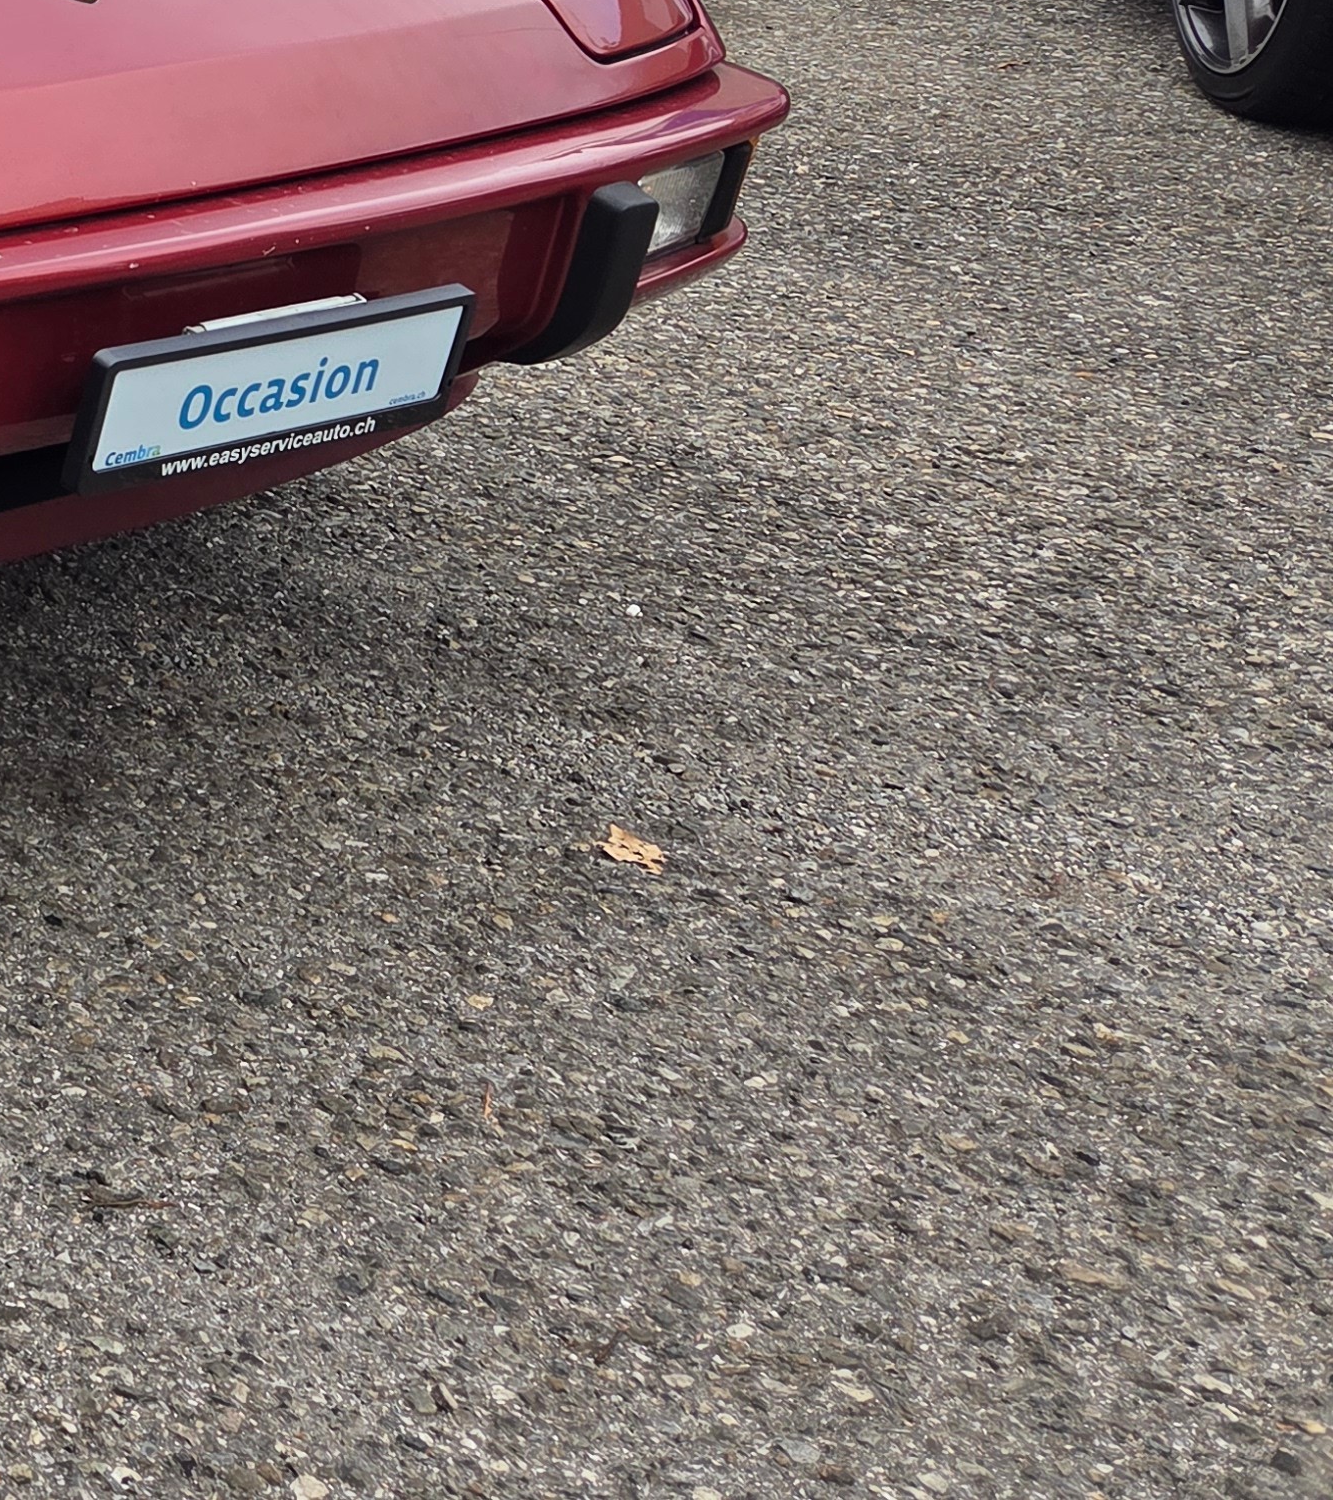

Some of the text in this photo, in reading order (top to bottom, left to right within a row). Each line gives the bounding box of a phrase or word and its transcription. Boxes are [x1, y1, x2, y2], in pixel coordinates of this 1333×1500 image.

[177, 355, 380, 432] Occasion
[104, 444, 162, 468] Cembra
[160, 416, 376, 477] www.easyserviceauto.ch
